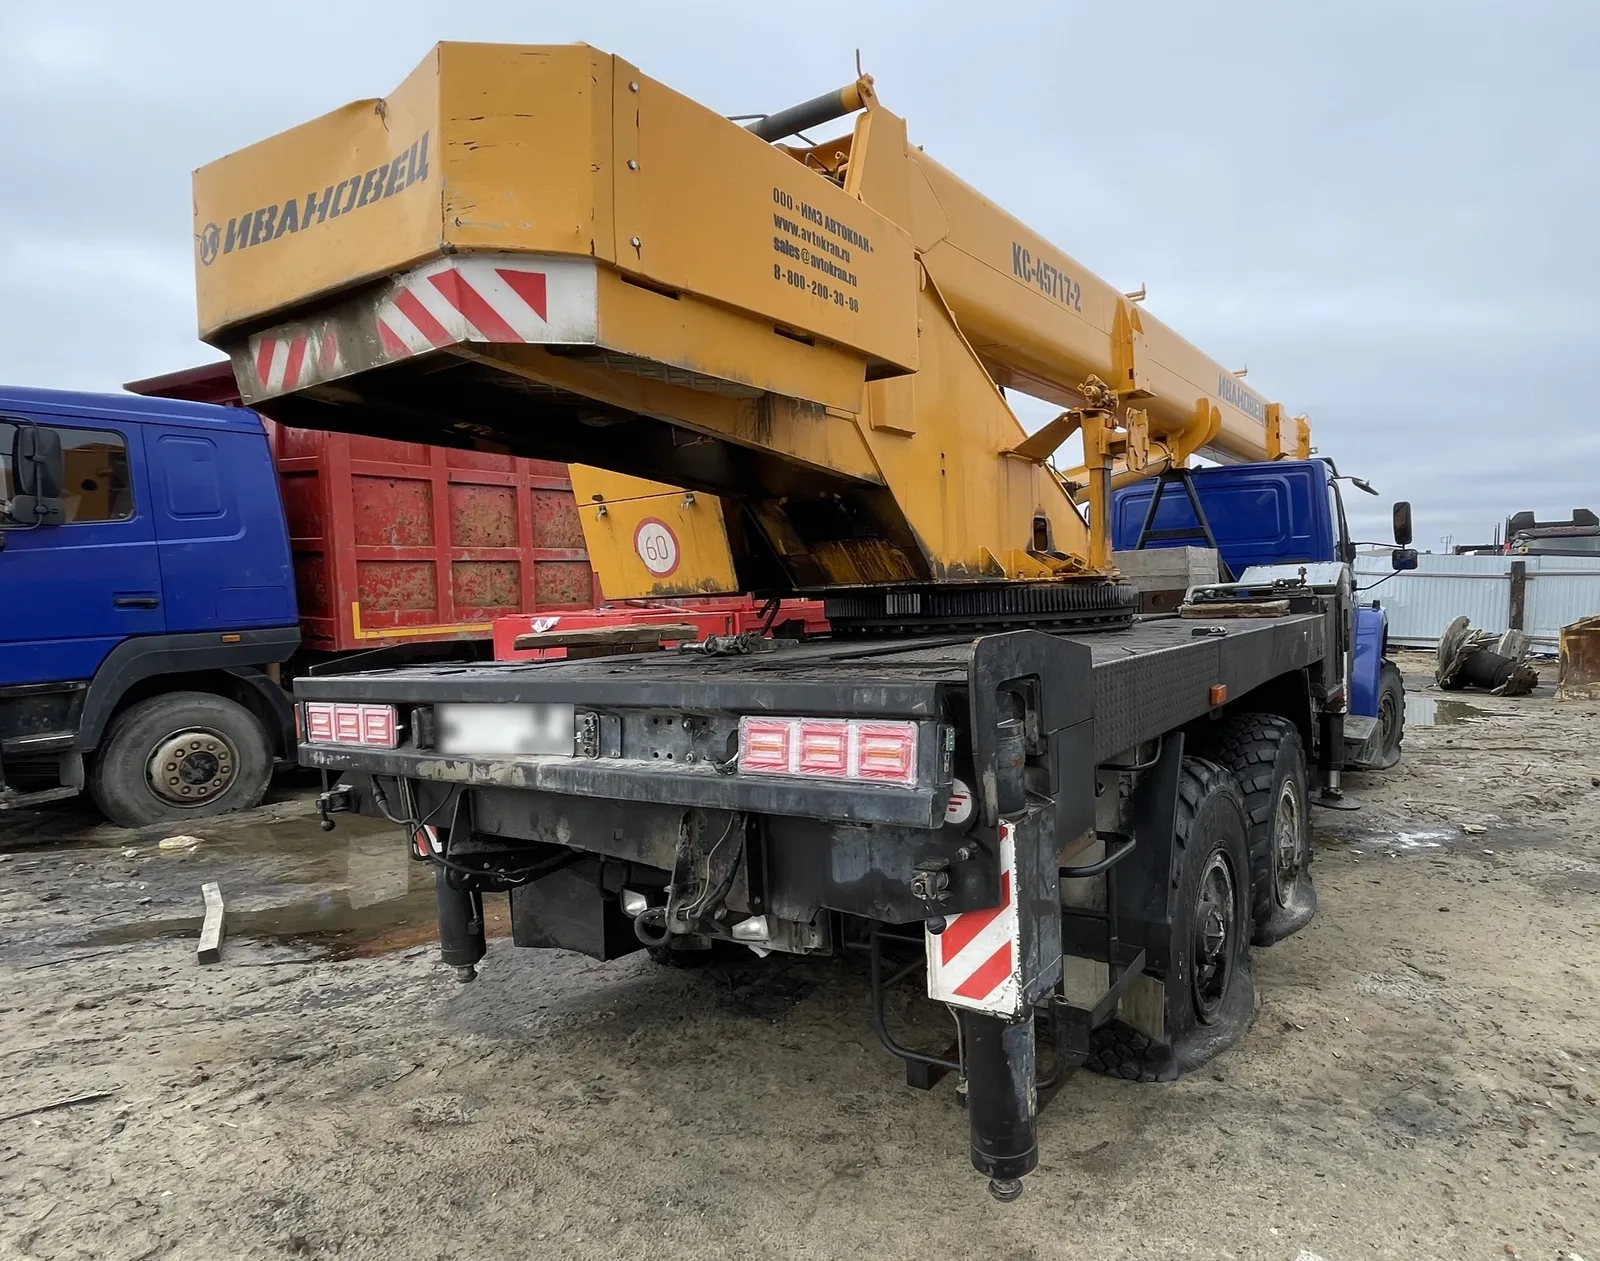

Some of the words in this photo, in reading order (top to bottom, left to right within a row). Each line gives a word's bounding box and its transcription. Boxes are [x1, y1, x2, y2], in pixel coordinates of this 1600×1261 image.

[223, 130, 430, 255] ИВАНОВЕЦ
[773, 187, 793, 211] ООО
[773, 213, 851, 263] www.avtokran.ru
[773, 236, 857, 288] sales@avtokran.ru
[773, 264, 859, 313] 8-800-200-30-98
[1012, 241, 1082, 314] КС-45717-2
[645, 535, 669, 560] 60
